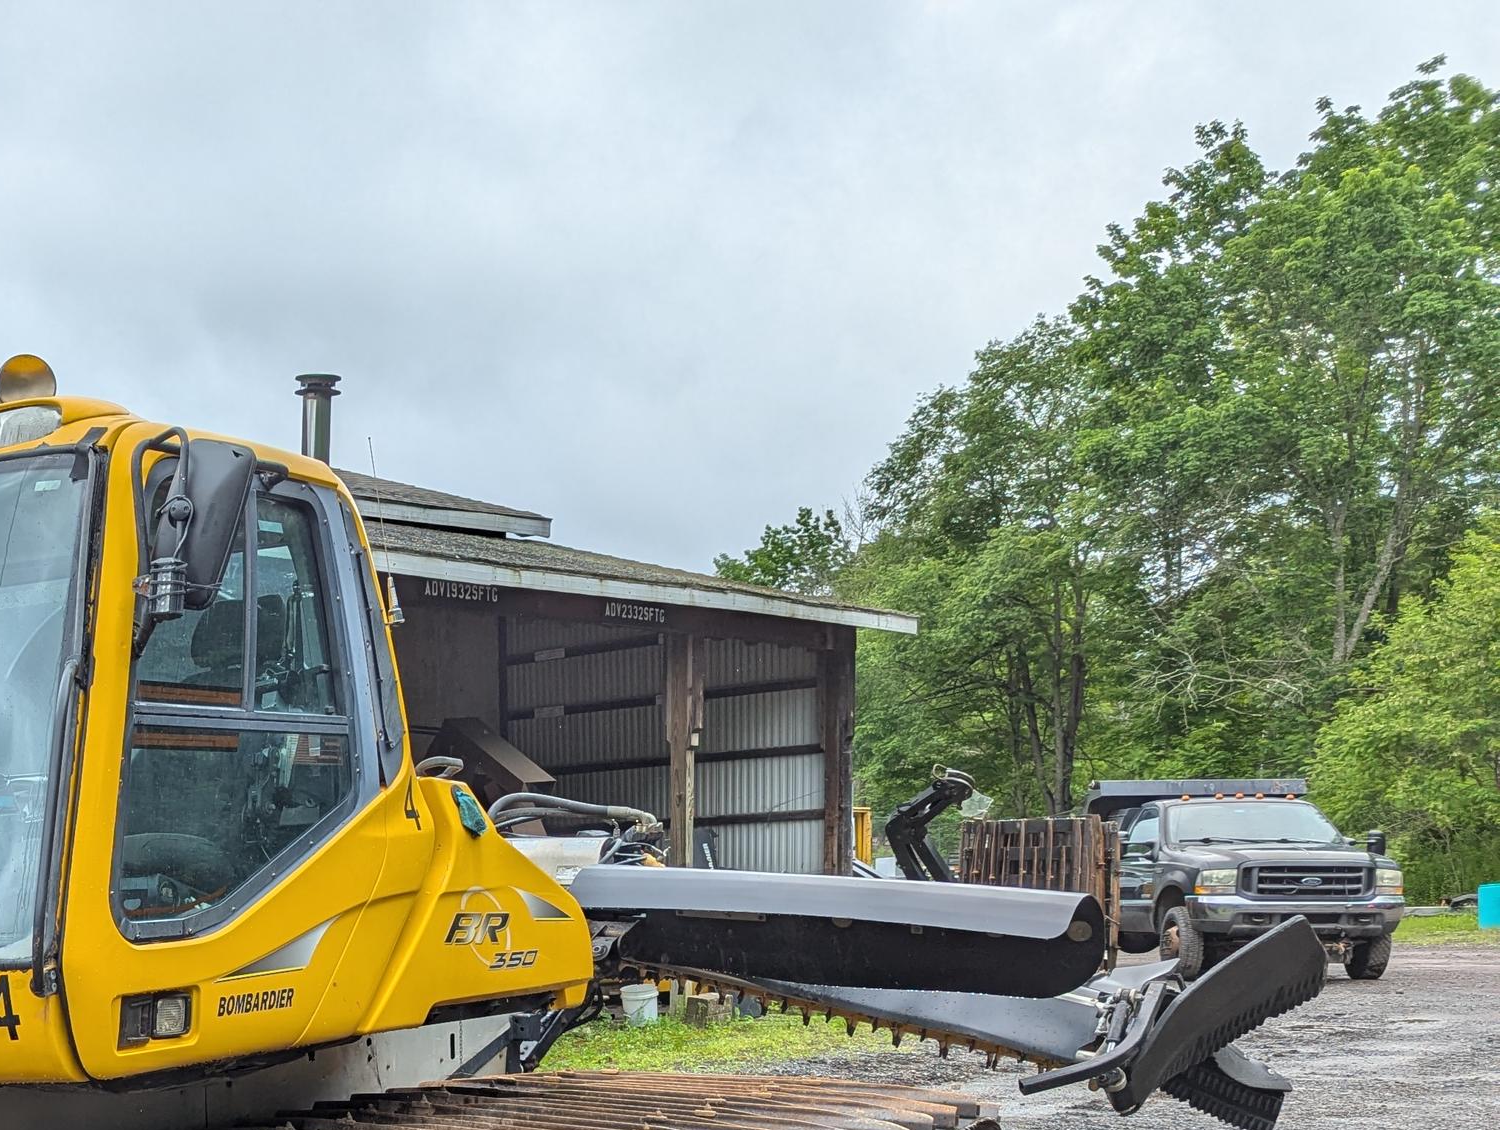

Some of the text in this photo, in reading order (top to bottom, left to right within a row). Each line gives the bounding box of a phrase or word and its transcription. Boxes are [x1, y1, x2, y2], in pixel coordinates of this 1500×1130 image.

[404, 775, 422, 831] 4
[444, 912, 510, 946] BR
[488, 950, 538, 970] 350
[217, 988, 295, 1018] BOMBARDIER
